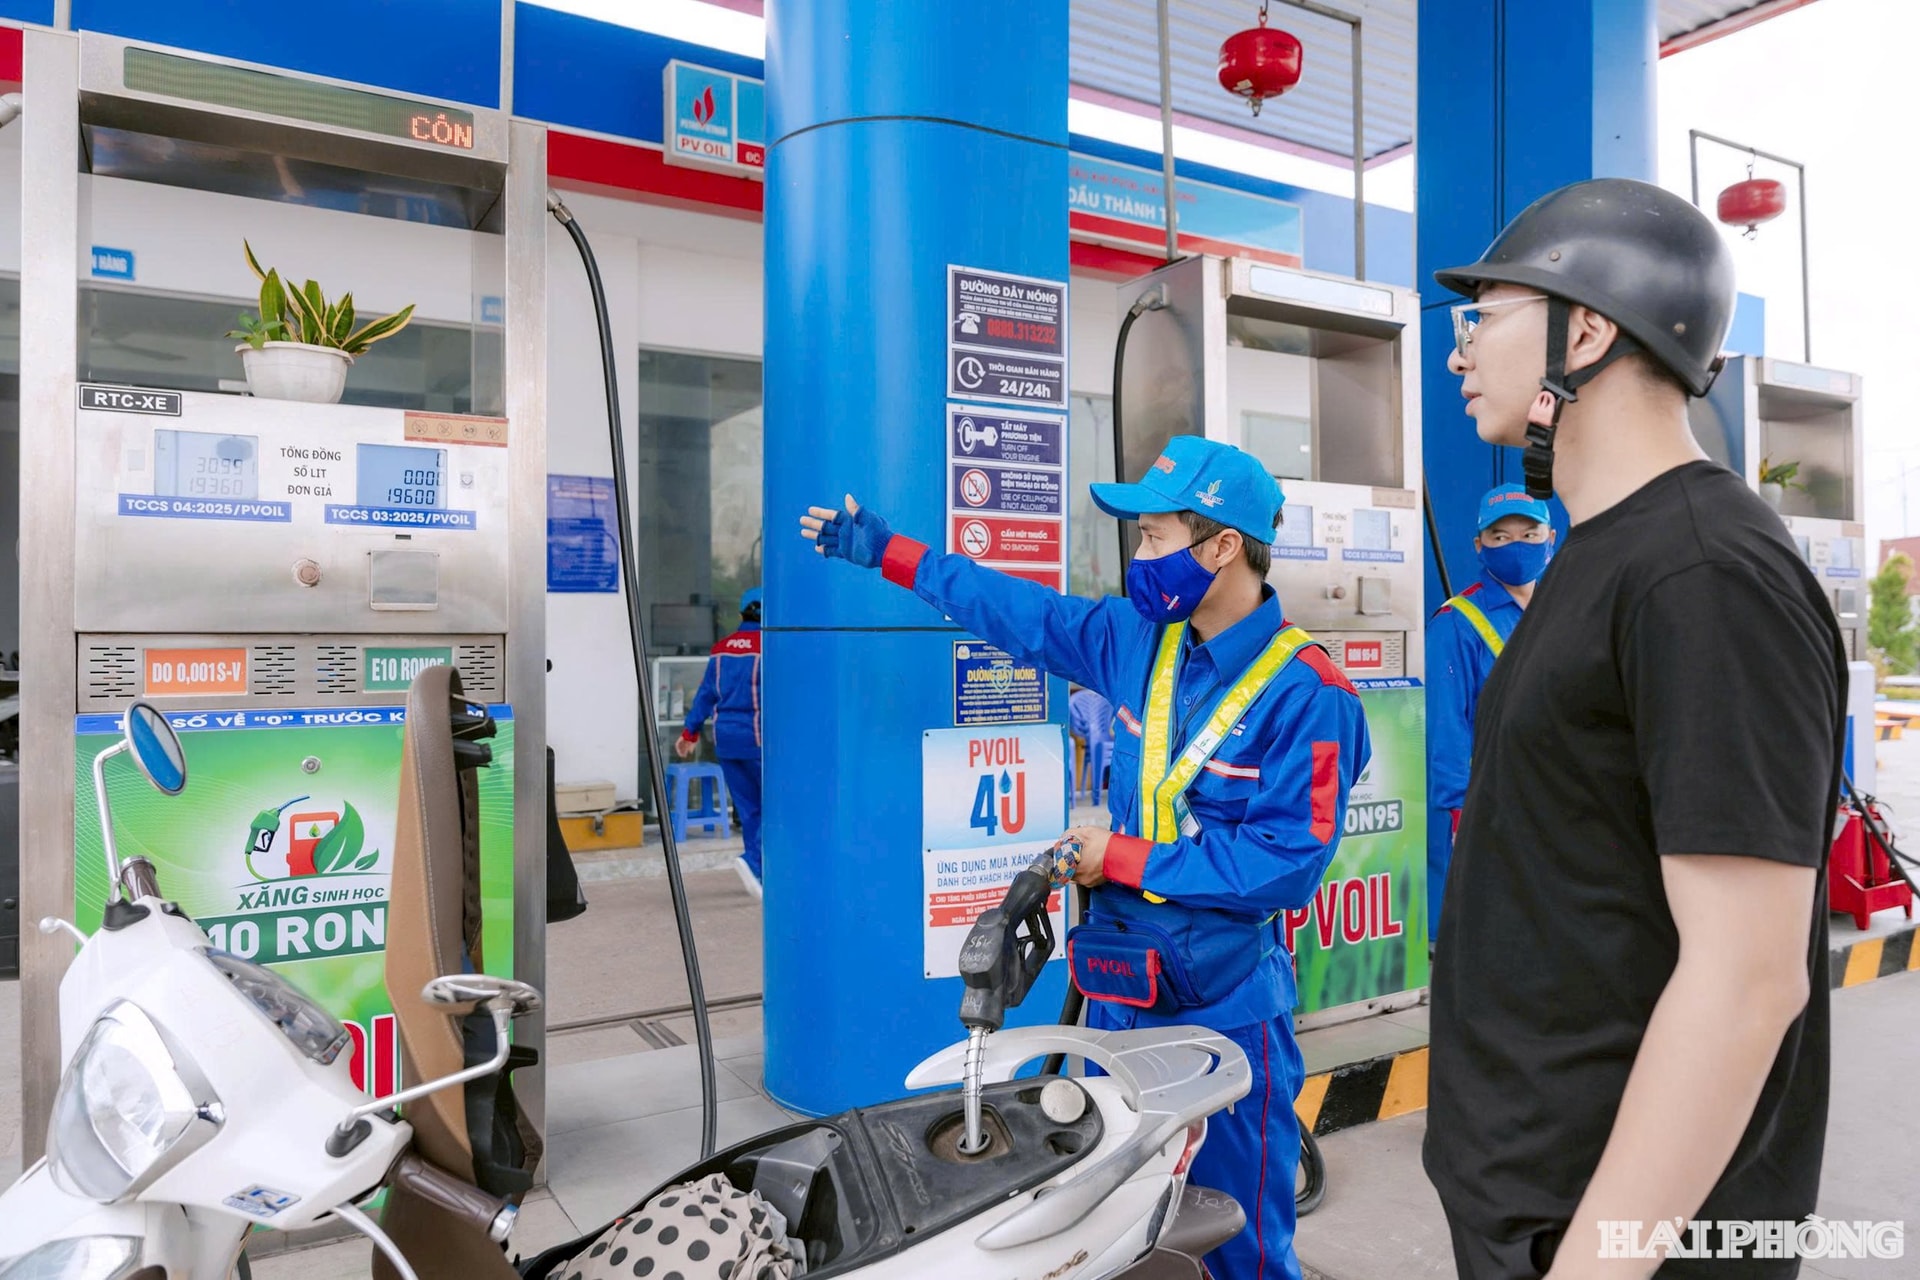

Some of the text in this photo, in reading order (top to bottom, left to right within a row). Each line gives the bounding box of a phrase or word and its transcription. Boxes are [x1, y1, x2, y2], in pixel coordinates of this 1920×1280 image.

[413, 114, 472, 148] CÔN
[680, 137, 728, 157] PV OIL
[1103, 193, 1155, 219] THÀNH
[960, 279, 1058, 304] ĐƯỜNG DÂY NÓNG
[988, 362, 1060, 378] THỜI GIAN BÁN HÀNG
[1000, 379, 1051, 398] 24/24h
[94, 391, 167, 410] RTC-XE
[281, 445, 342, 461] TỔNG ĐỒNG
[294, 464, 308, 478] SỐ
[288, 484, 311, 496] ĐƠN
[388, 488, 436, 505] 19600
[1001, 493, 1012, 501] USE
[126, 499, 285, 517] TCCS 04:2025/PVOIL
[1007, 502, 1020, 510] NOT
[331, 508, 471, 526] TCCS 03:2025/PVOIL
[1001, 543, 1011, 551] NO
[152, 661, 172, 684] DO
[371, 656, 398, 682] E10
[172, 713, 208, 728] SỐ
[216, 711, 246, 727] VỀ
[301, 710, 383, 725] TRƯỚC
[969, 737, 1025, 768] PVOIL
[1344, 803, 1399, 834] ON95
[990, 857, 1008, 869] MUA
[962, 876, 977, 886] CHO
[236, 885, 385, 911] XĂNG SINH HỌC
[1284, 872, 1403, 955] PVOIL
[206, 920, 260, 960] 10
[1087, 957, 1135, 977] PVOIL
